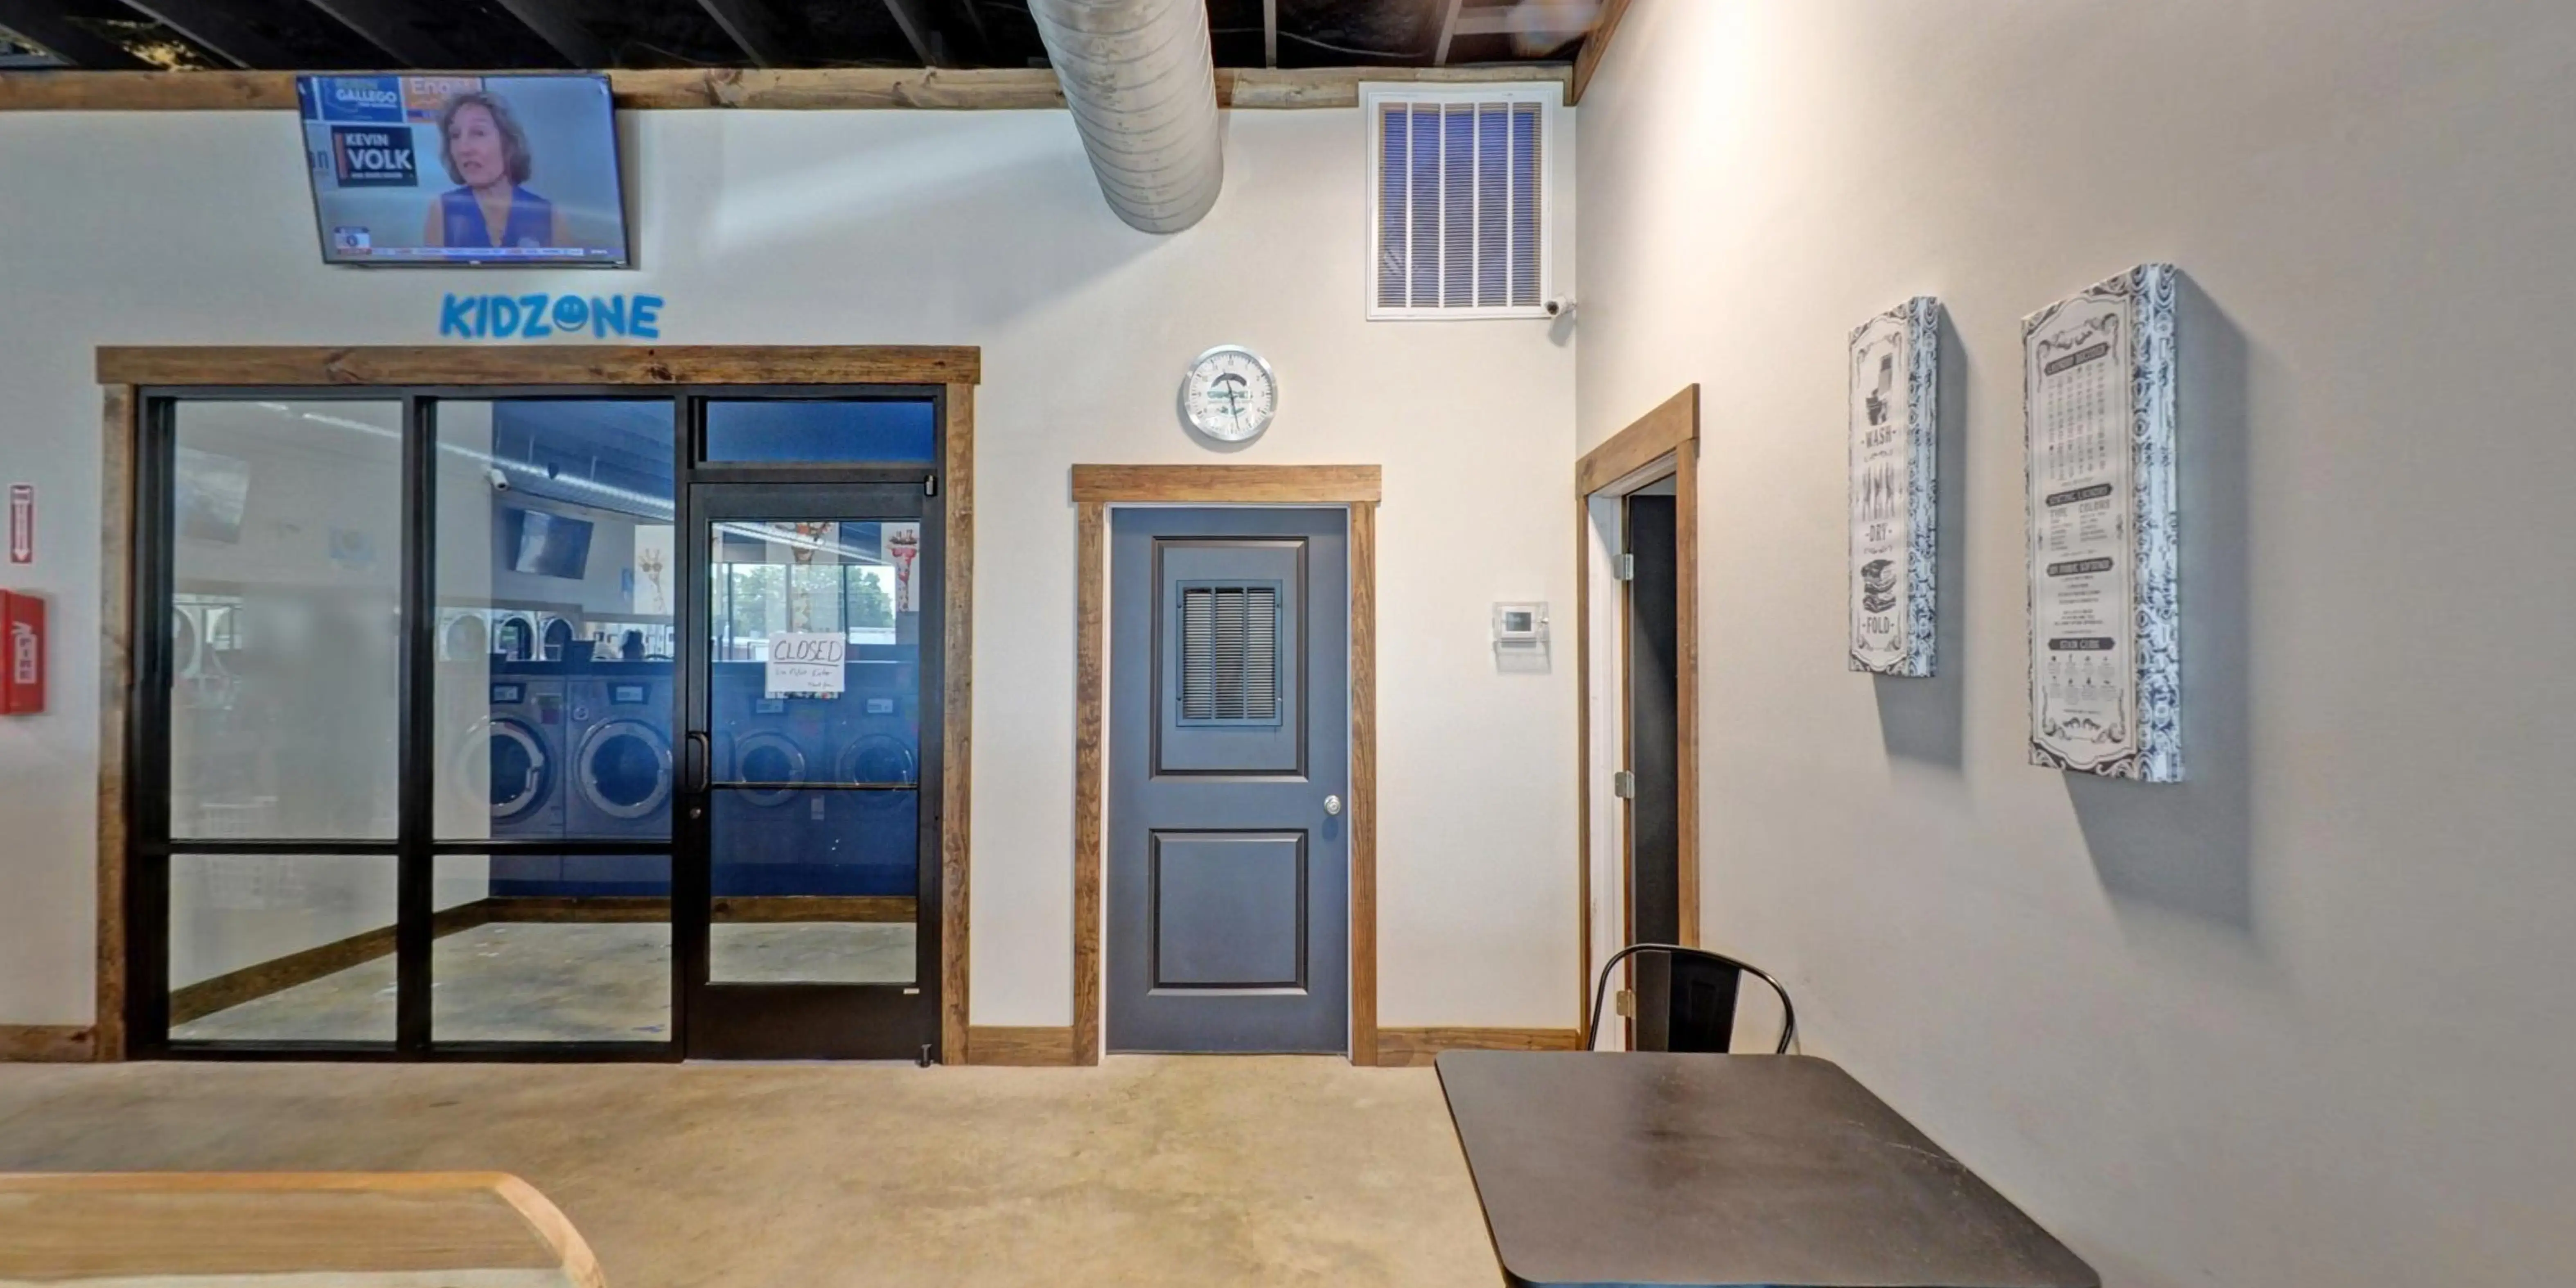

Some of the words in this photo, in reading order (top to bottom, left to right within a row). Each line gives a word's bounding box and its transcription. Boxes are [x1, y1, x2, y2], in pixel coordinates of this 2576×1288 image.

[336, 88, 397, 103] GALLEGO
[346, 133, 388, 146] KEVIN
[347, 148, 412, 169] VOLK
[440, 293, 664, 338] KIDZONE
[1865, 425, 1892, 448] WASH
[1869, 523, 1888, 542] DRY
[1866, 616, 1890, 634] FOLD
[19, 638, 33, 679] FIRE
[774, 640, 842, 662] CLOSED
